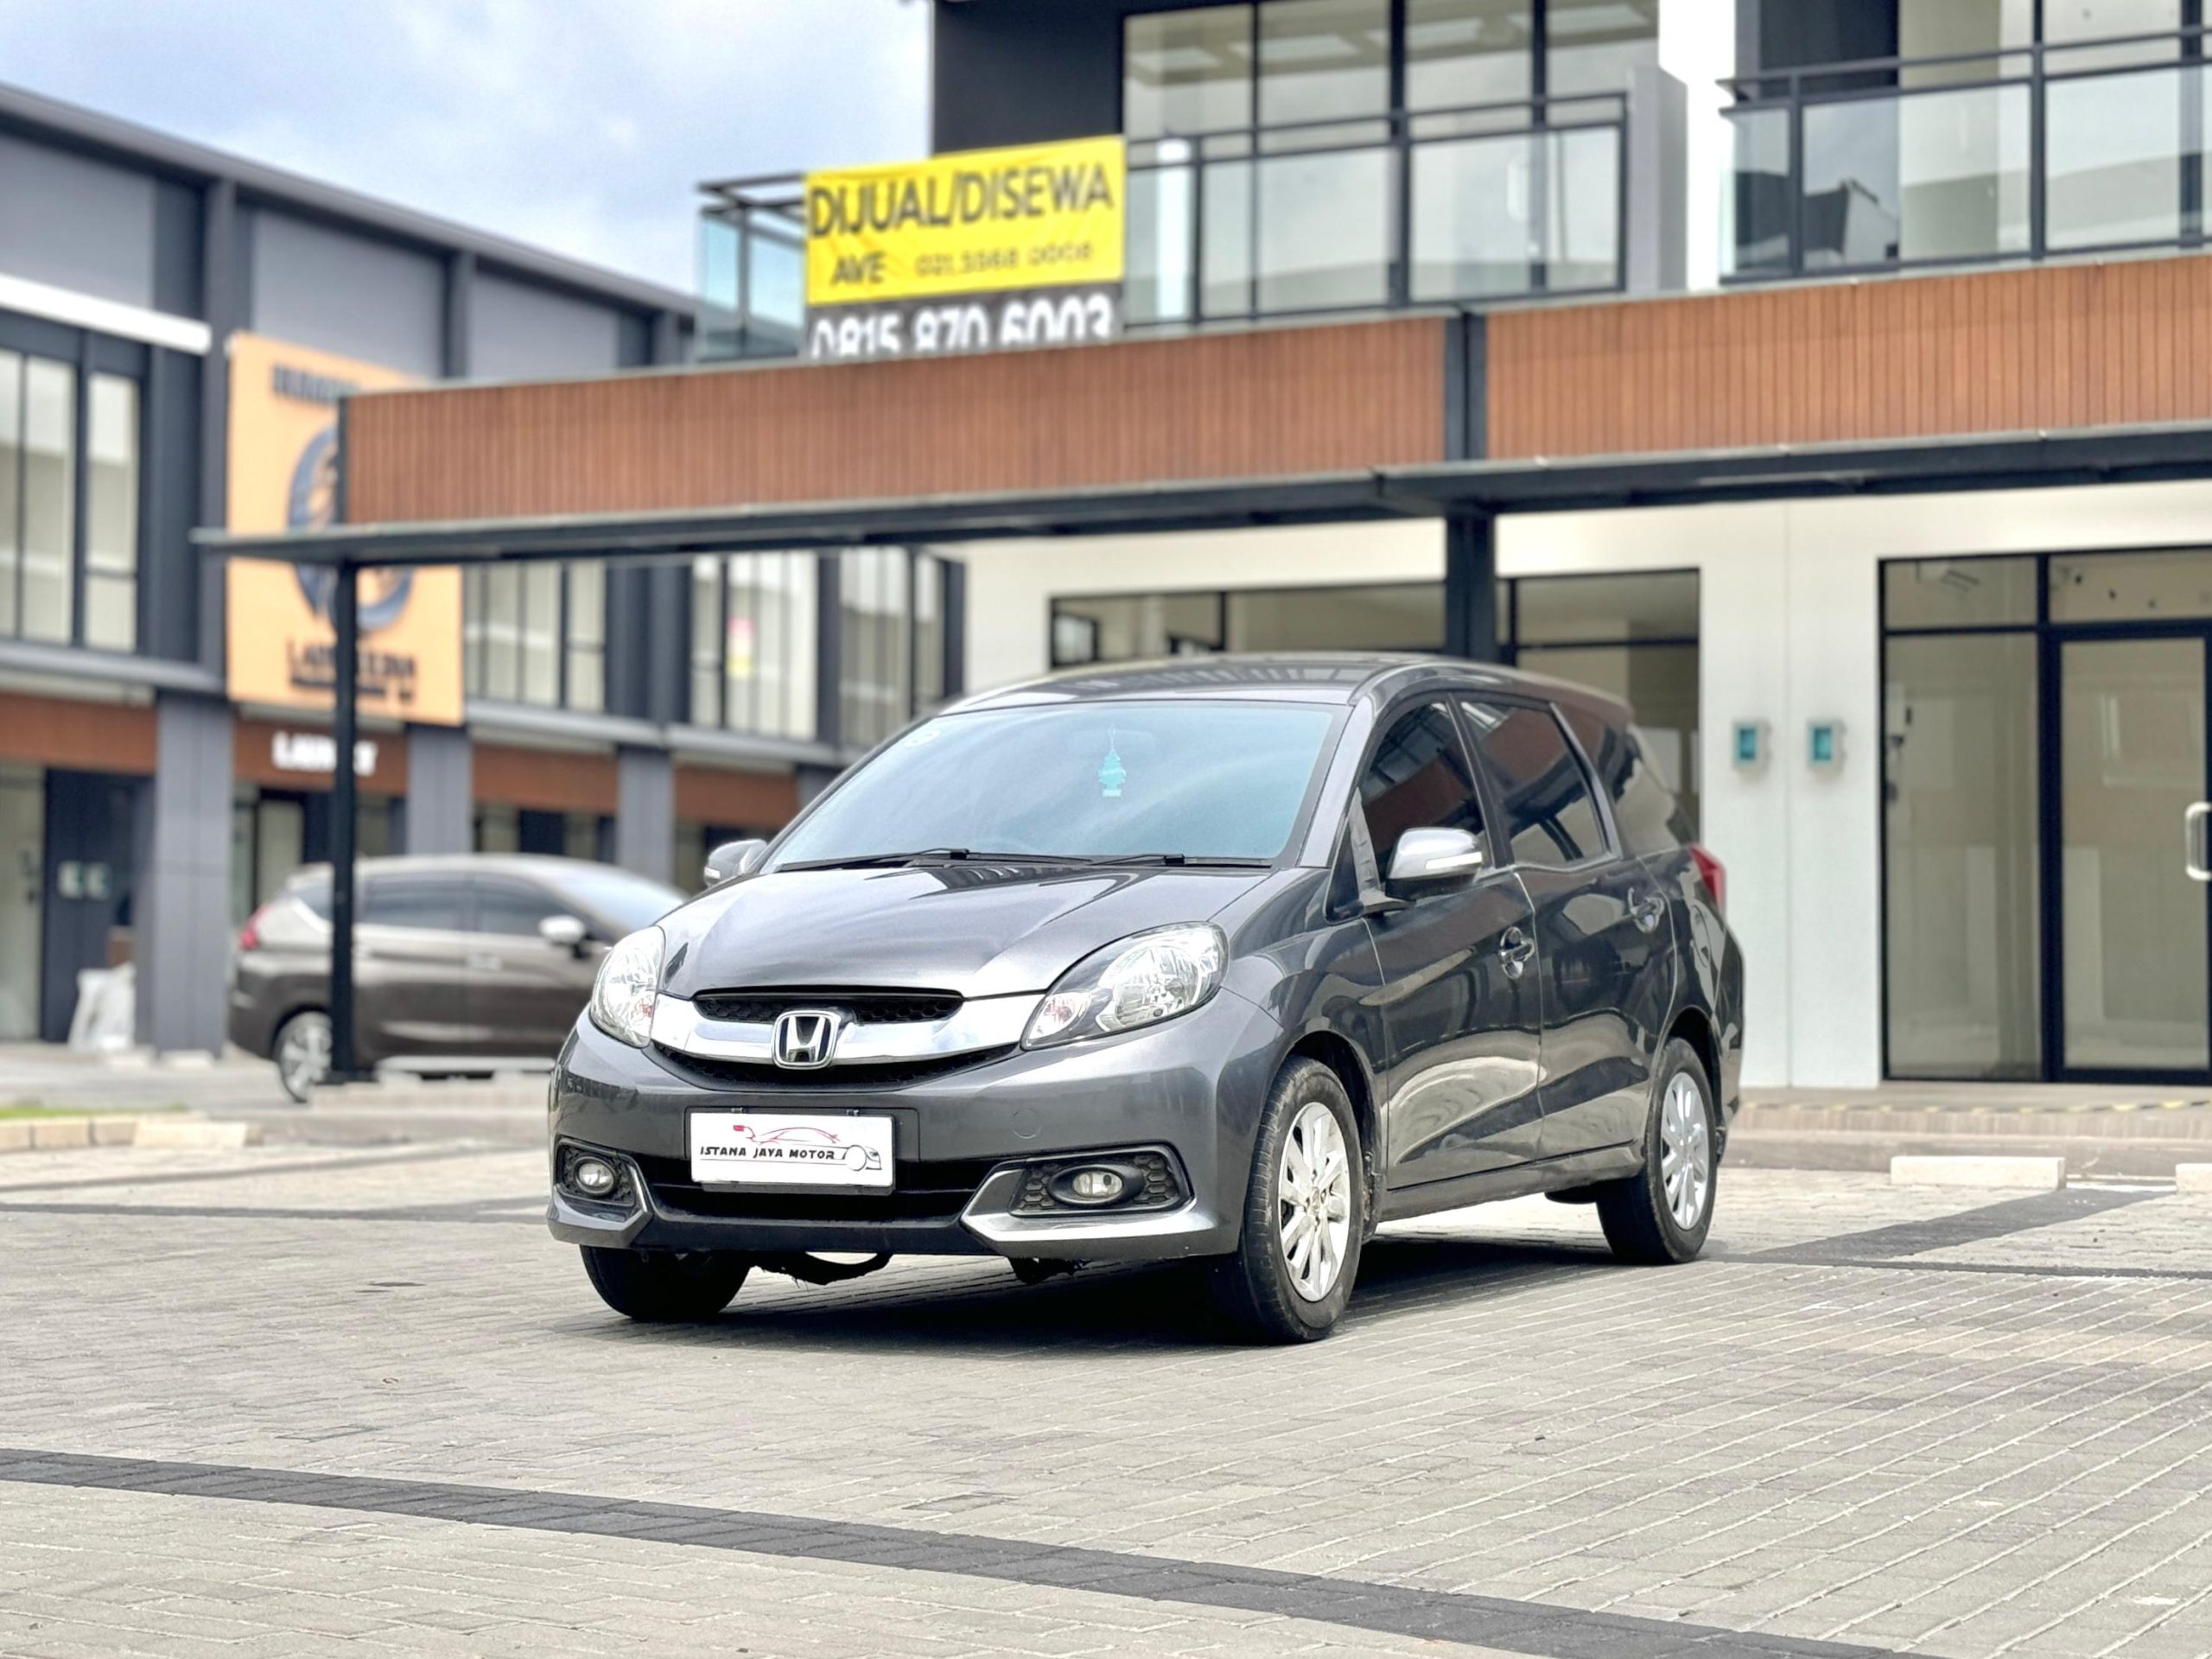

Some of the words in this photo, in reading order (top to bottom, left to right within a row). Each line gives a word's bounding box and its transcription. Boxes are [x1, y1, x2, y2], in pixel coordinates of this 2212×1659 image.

[810, 164, 1114, 238] DIJUAL/DISEWA
[700, 1146, 747, 1156] ISTANA
[753, 1147, 783, 1159] JAYA
[789, 1149, 835, 1160] MOTOR
